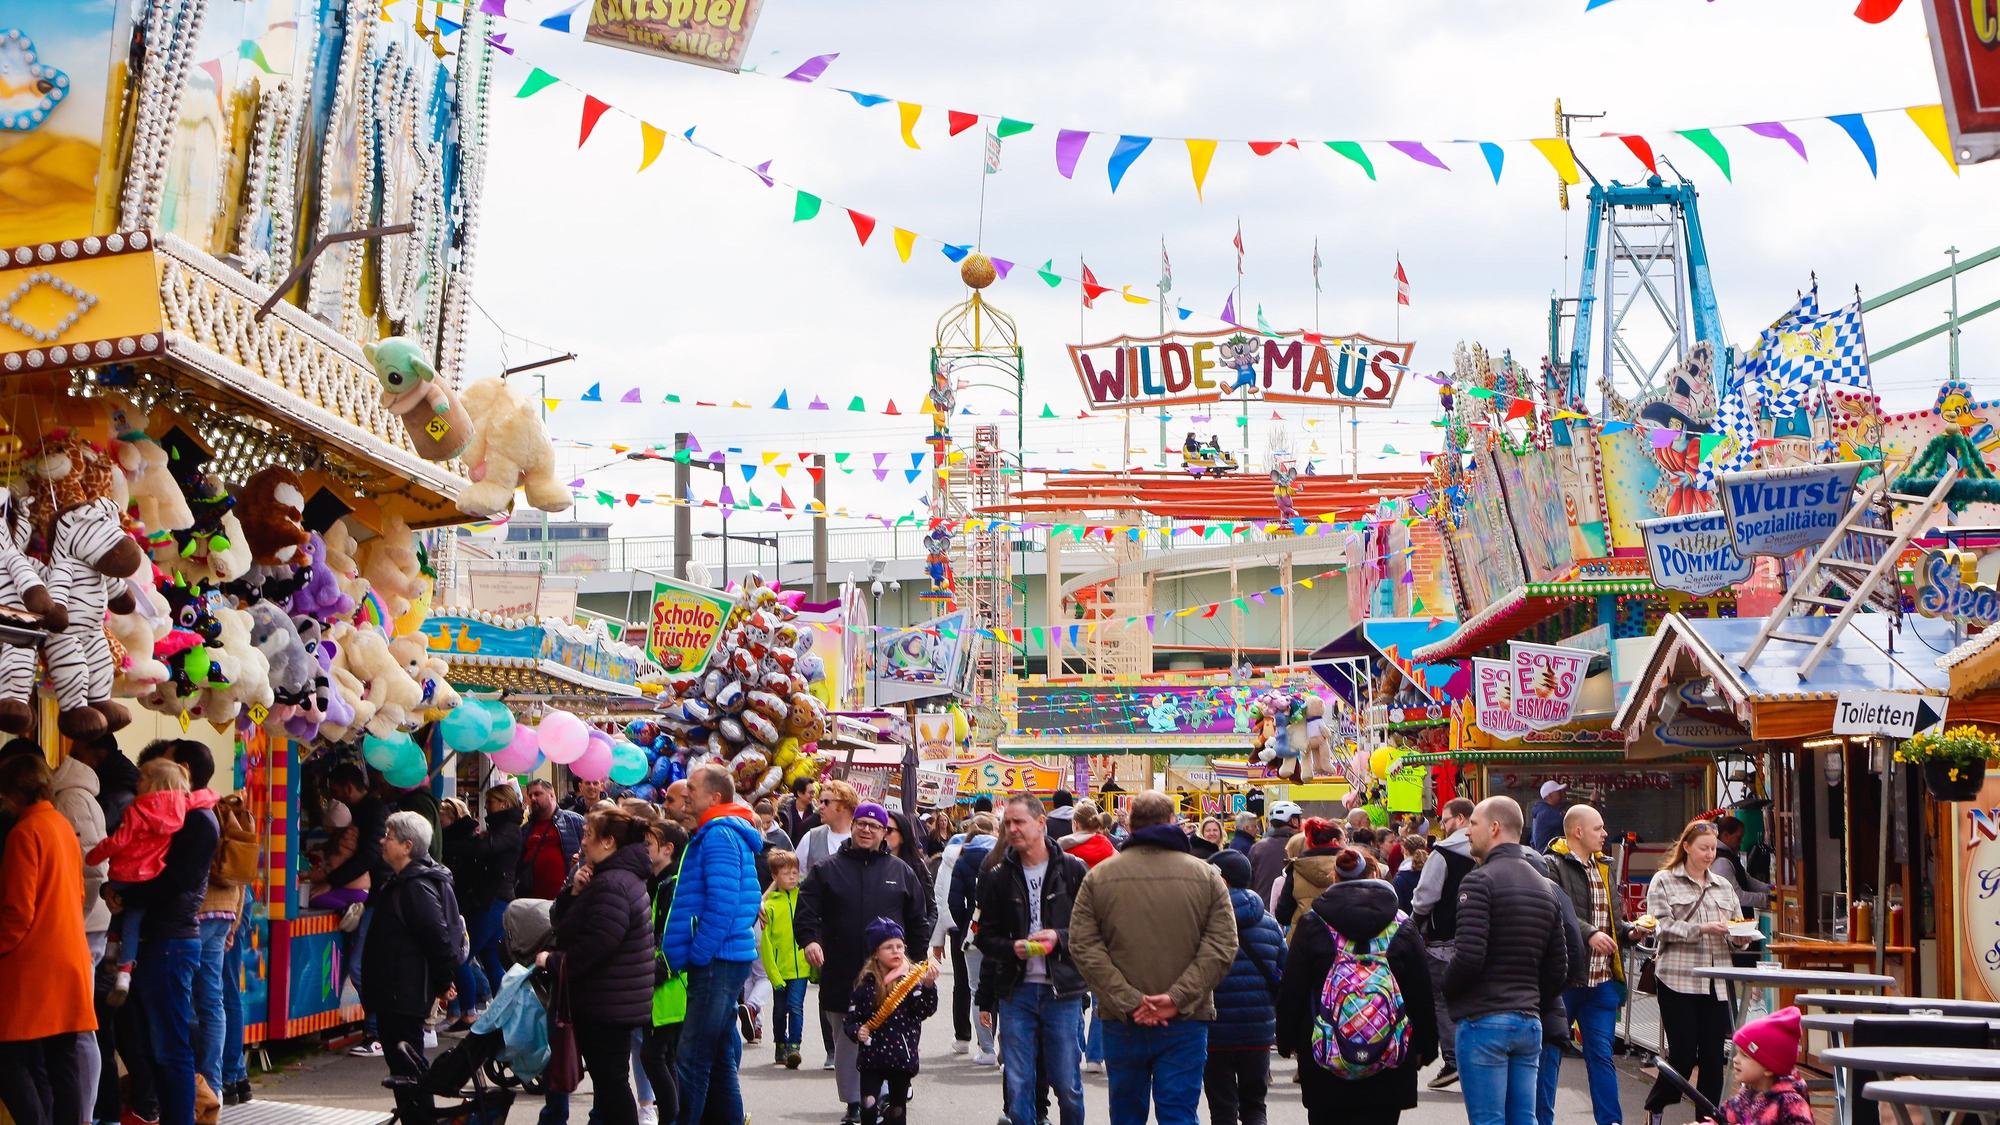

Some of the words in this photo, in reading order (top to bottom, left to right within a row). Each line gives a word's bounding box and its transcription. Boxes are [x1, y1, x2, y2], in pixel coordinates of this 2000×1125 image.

[627, 25, 664, 46] für
[671, 31, 734, 61] Alle!
[1081, 341, 1217, 401] WILDE
[1263, 339, 1400, 400] MAUS
[430, 420, 446, 433] 5x
[1729, 476, 1852, 517] Wurst-
[1736, 510, 1838, 546] Spezialitäten
[1684, 572, 1723, 584] Qualität
[653, 601, 720, 629] Schoko-
[653, 626, 711, 650] früchte
[1516, 651, 1582, 673] SOFT
[1516, 698, 1569, 720] EISMOHR
[1841, 701, 1915, 727] Toiletten
[958, 763, 1037, 790] ASSE
[1201, 793, 1247, 815] WIR
